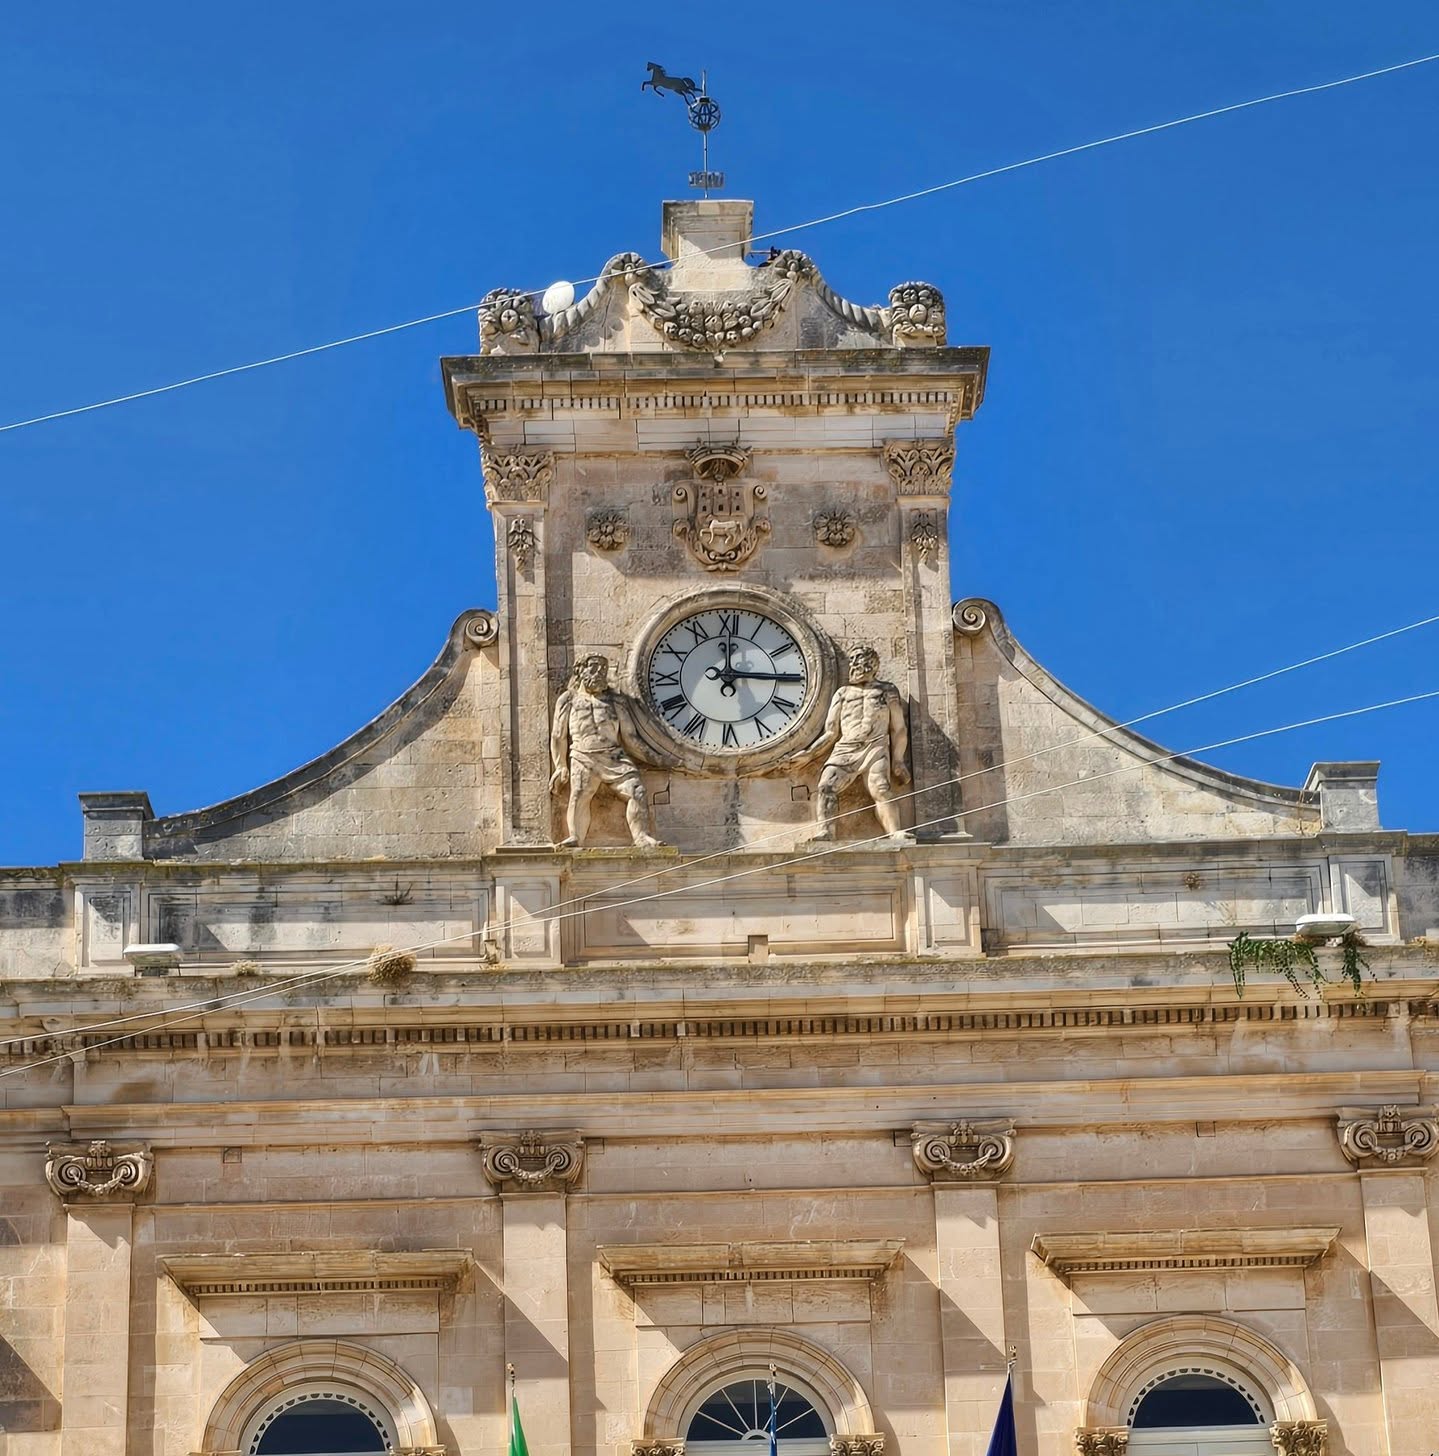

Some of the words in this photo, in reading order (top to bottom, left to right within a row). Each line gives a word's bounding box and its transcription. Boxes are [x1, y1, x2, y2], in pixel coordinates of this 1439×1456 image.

[684, 620, 709, 644] XI
[718, 614, 739, 636] XII
[750, 617, 765, 640] I
[662, 643, 687, 662] X
[769, 642, 793, 658] II
[655, 670, 679, 686] IX
[661, 694, 687, 719] VIII
[771, 695, 795, 720] IV
[683, 713, 706, 739] VII
[722, 723, 739, 747] VI
[754, 717, 772, 738] V
